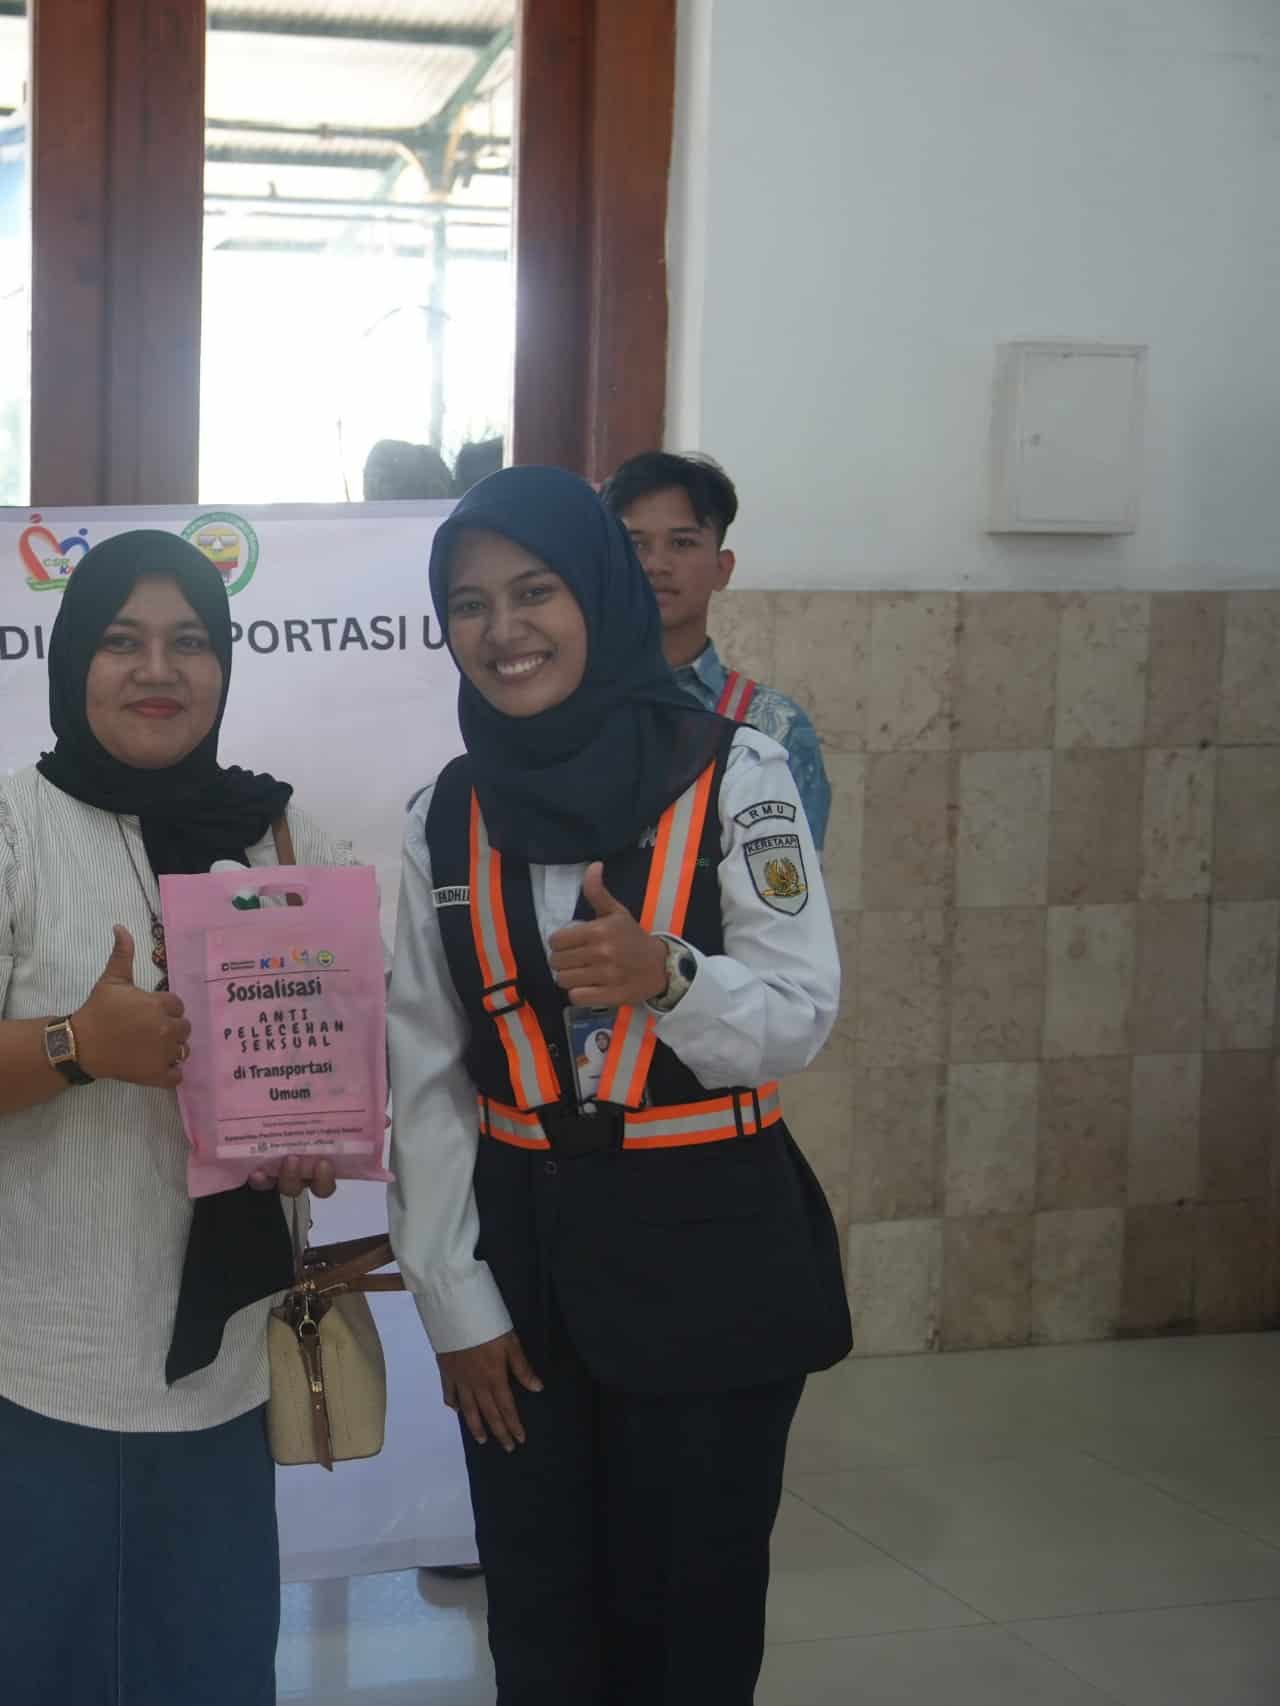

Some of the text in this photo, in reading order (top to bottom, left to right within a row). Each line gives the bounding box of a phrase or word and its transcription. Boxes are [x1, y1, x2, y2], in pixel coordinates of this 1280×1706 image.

[748, 804, 785, 820] RMU
[226, 976, 323, 1003] Sosialisasi
[259, 1008, 308, 1023] ANTI
[223, 1020, 344, 1041] PELECEHAN
[240, 1034, 332, 1053] SEKSUAL
[233, 1060, 333, 1080] di Transportasi
[269, 1087, 312, 1101] Umum
